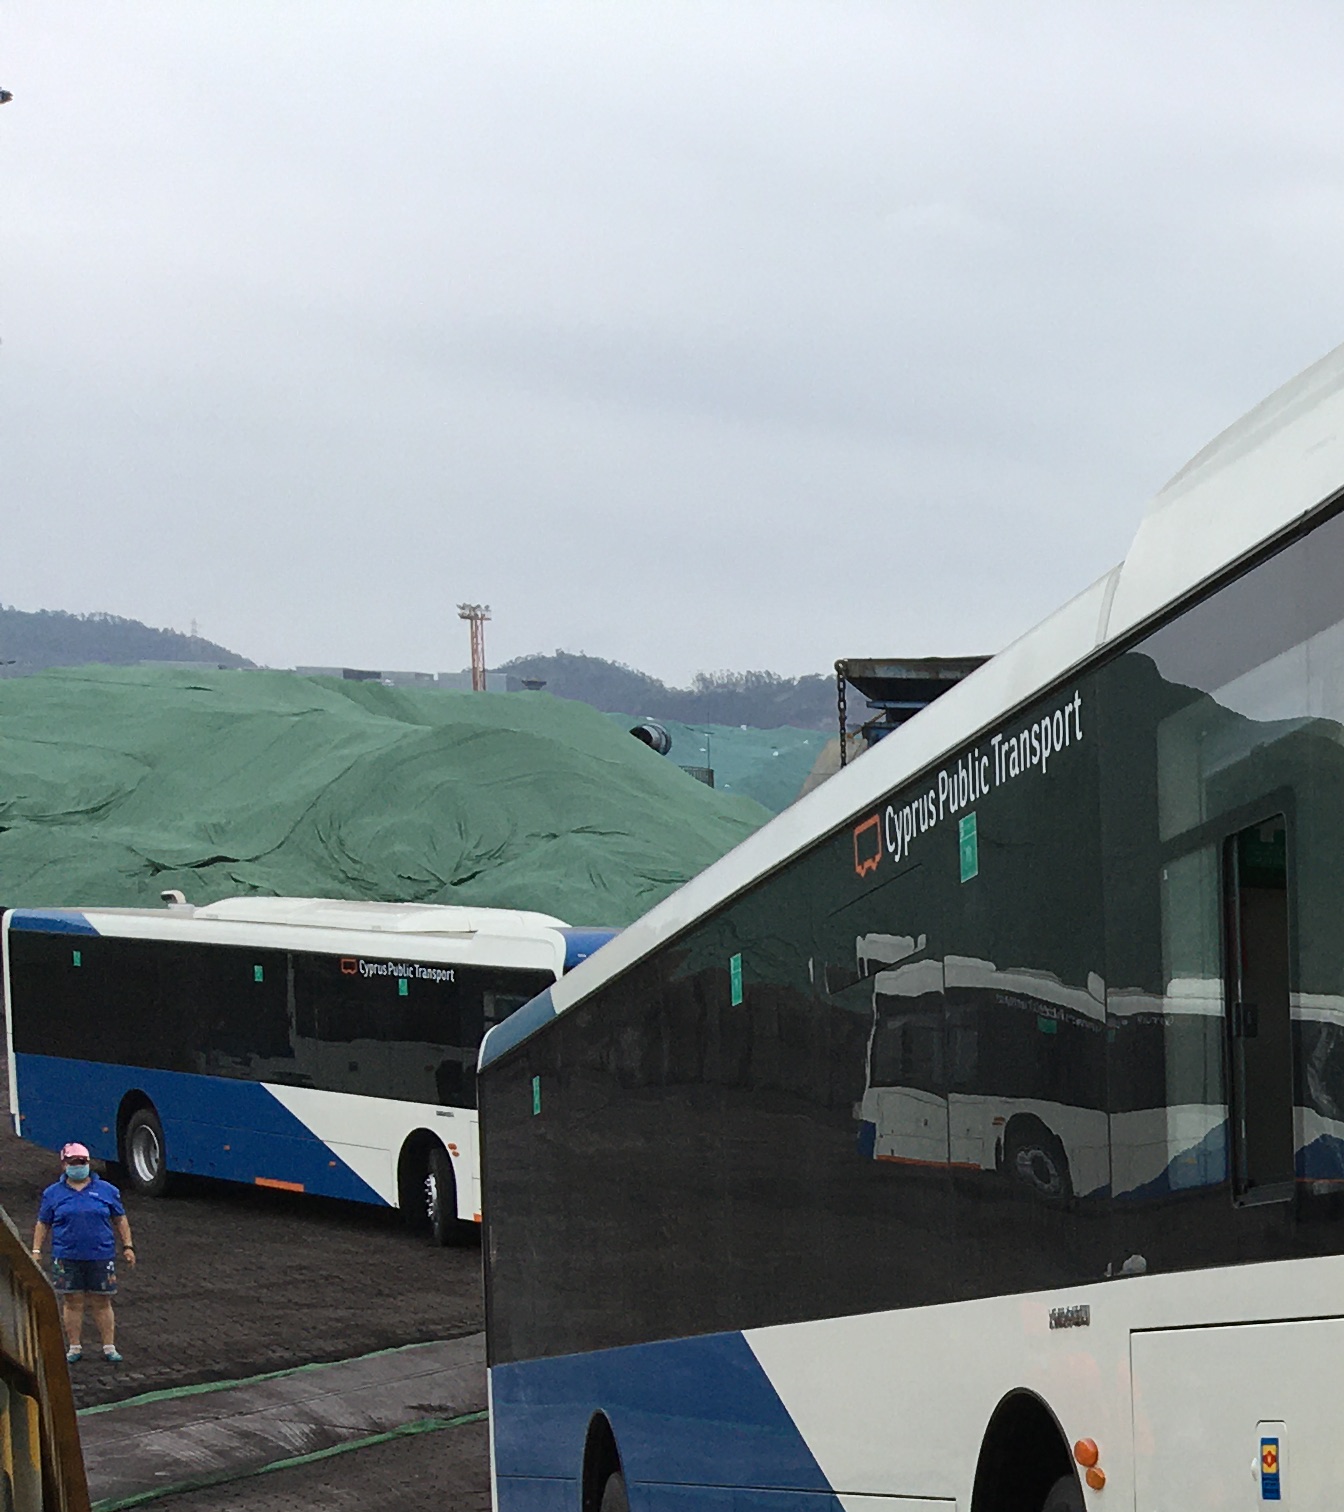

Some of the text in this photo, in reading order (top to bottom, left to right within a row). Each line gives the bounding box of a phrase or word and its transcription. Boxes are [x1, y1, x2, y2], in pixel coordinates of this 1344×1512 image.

[885, 690, 1082, 862] Cyprus Public Transport
[359, 960, 455, 983] Cyprus Public Transport
